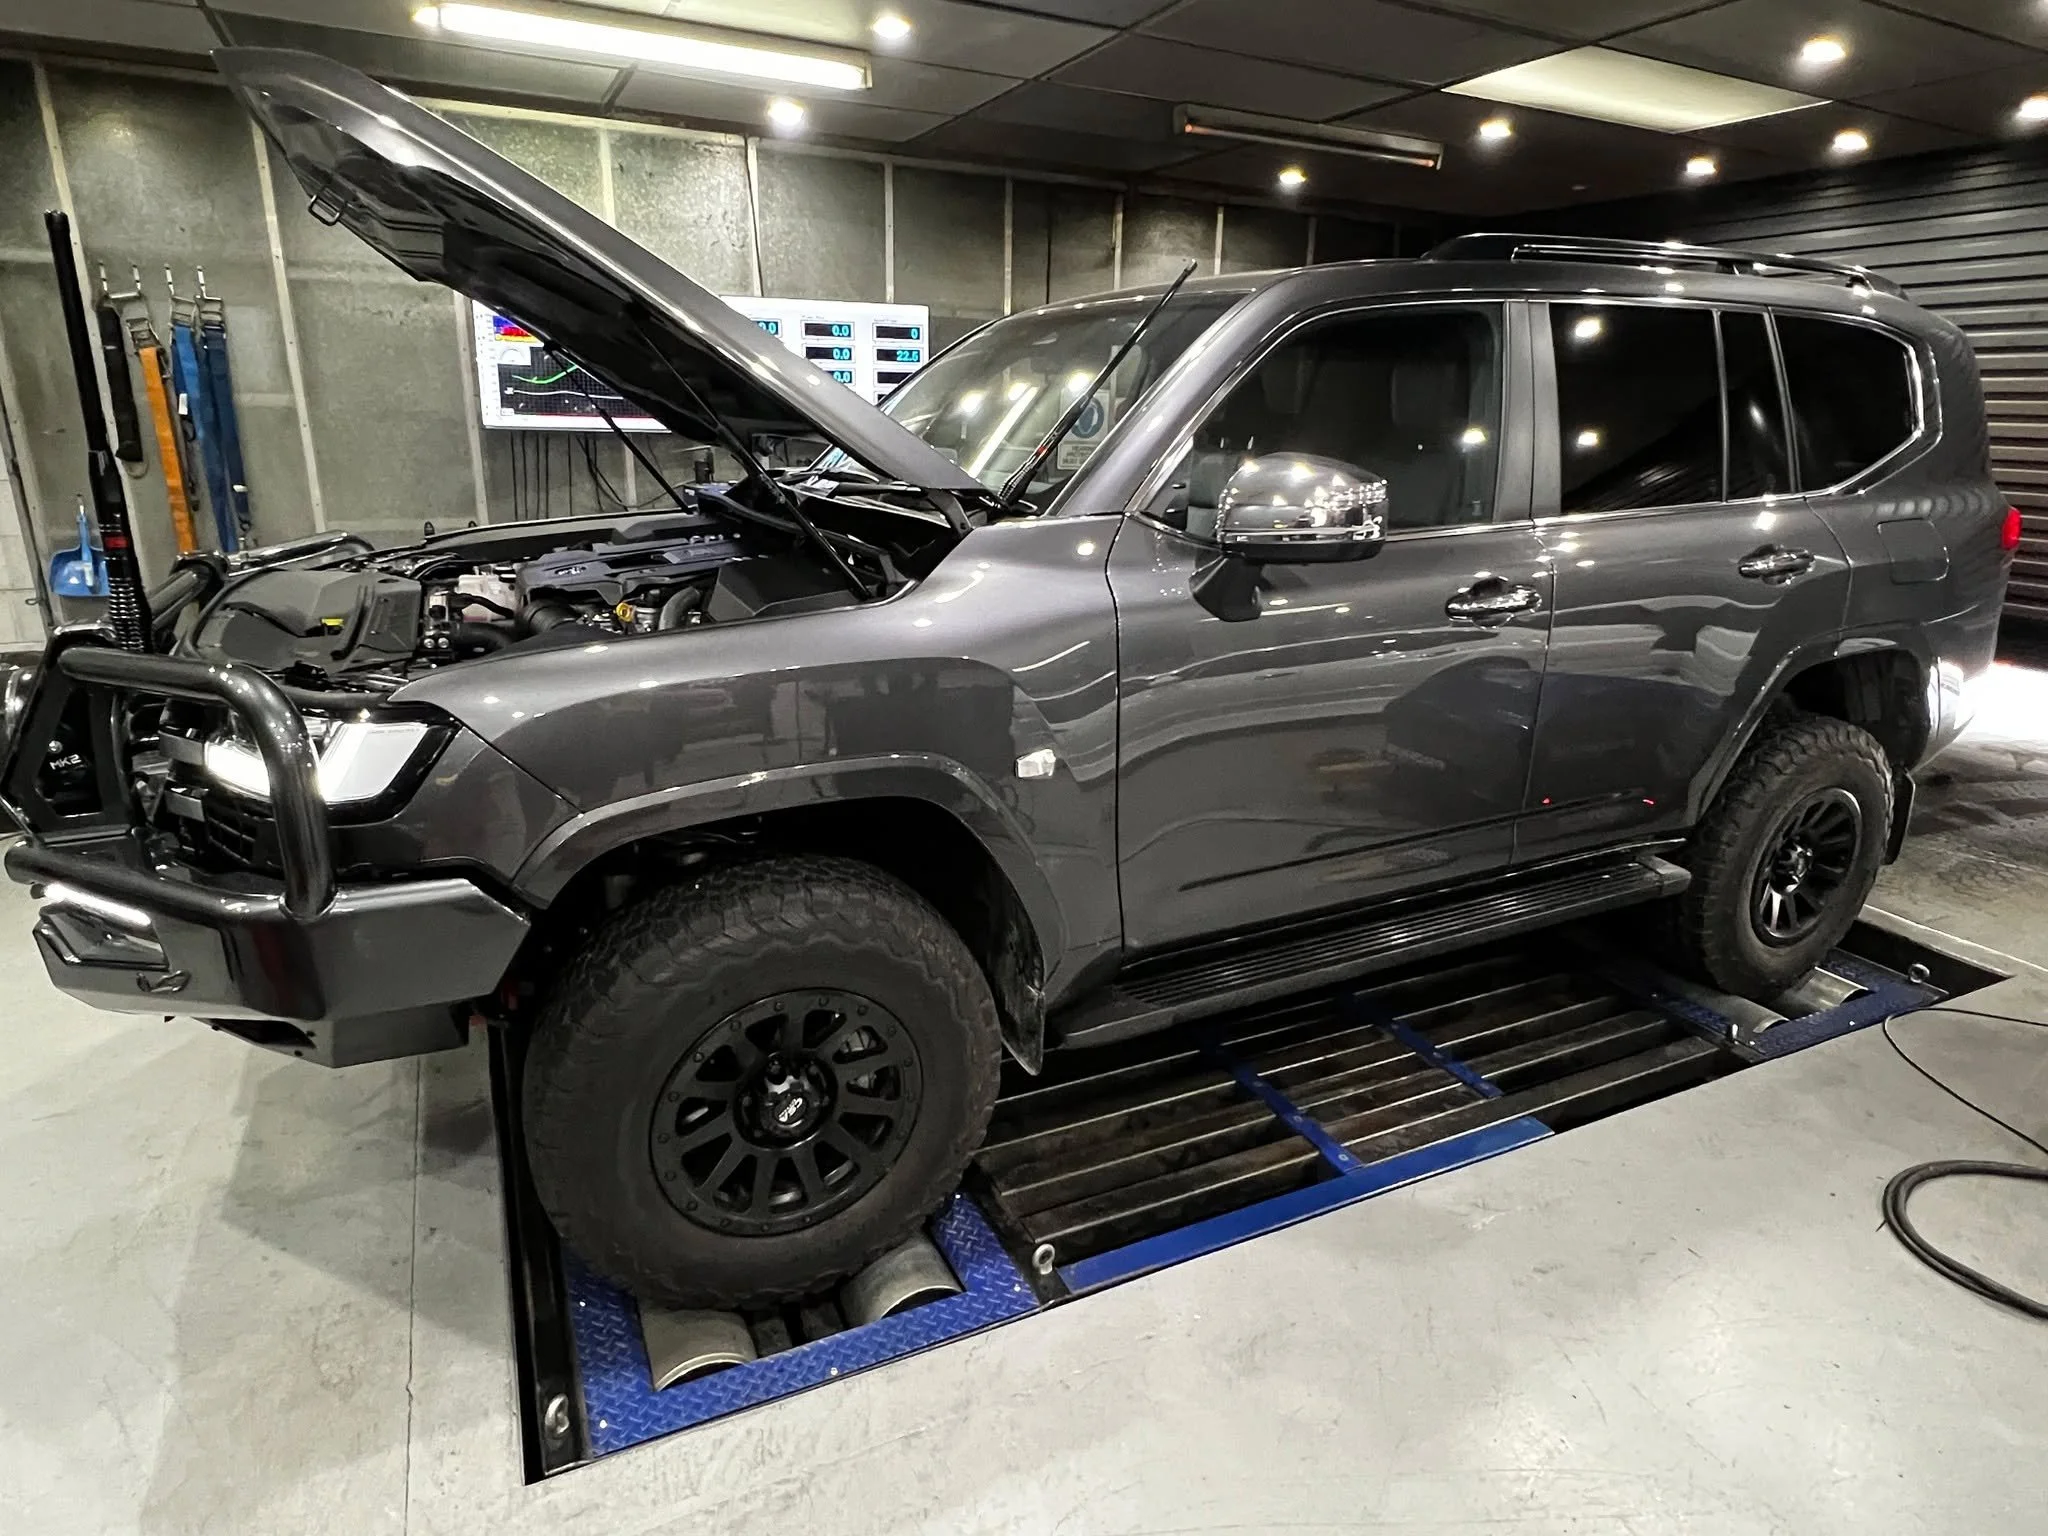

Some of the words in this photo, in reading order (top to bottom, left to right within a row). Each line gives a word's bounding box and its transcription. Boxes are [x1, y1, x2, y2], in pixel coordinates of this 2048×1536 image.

[831, 324, 849, 336] 0.0
[911, 328, 919, 339] 0
[833, 348, 850, 360] 0.0
[49, 753, 82, 770] MK2
